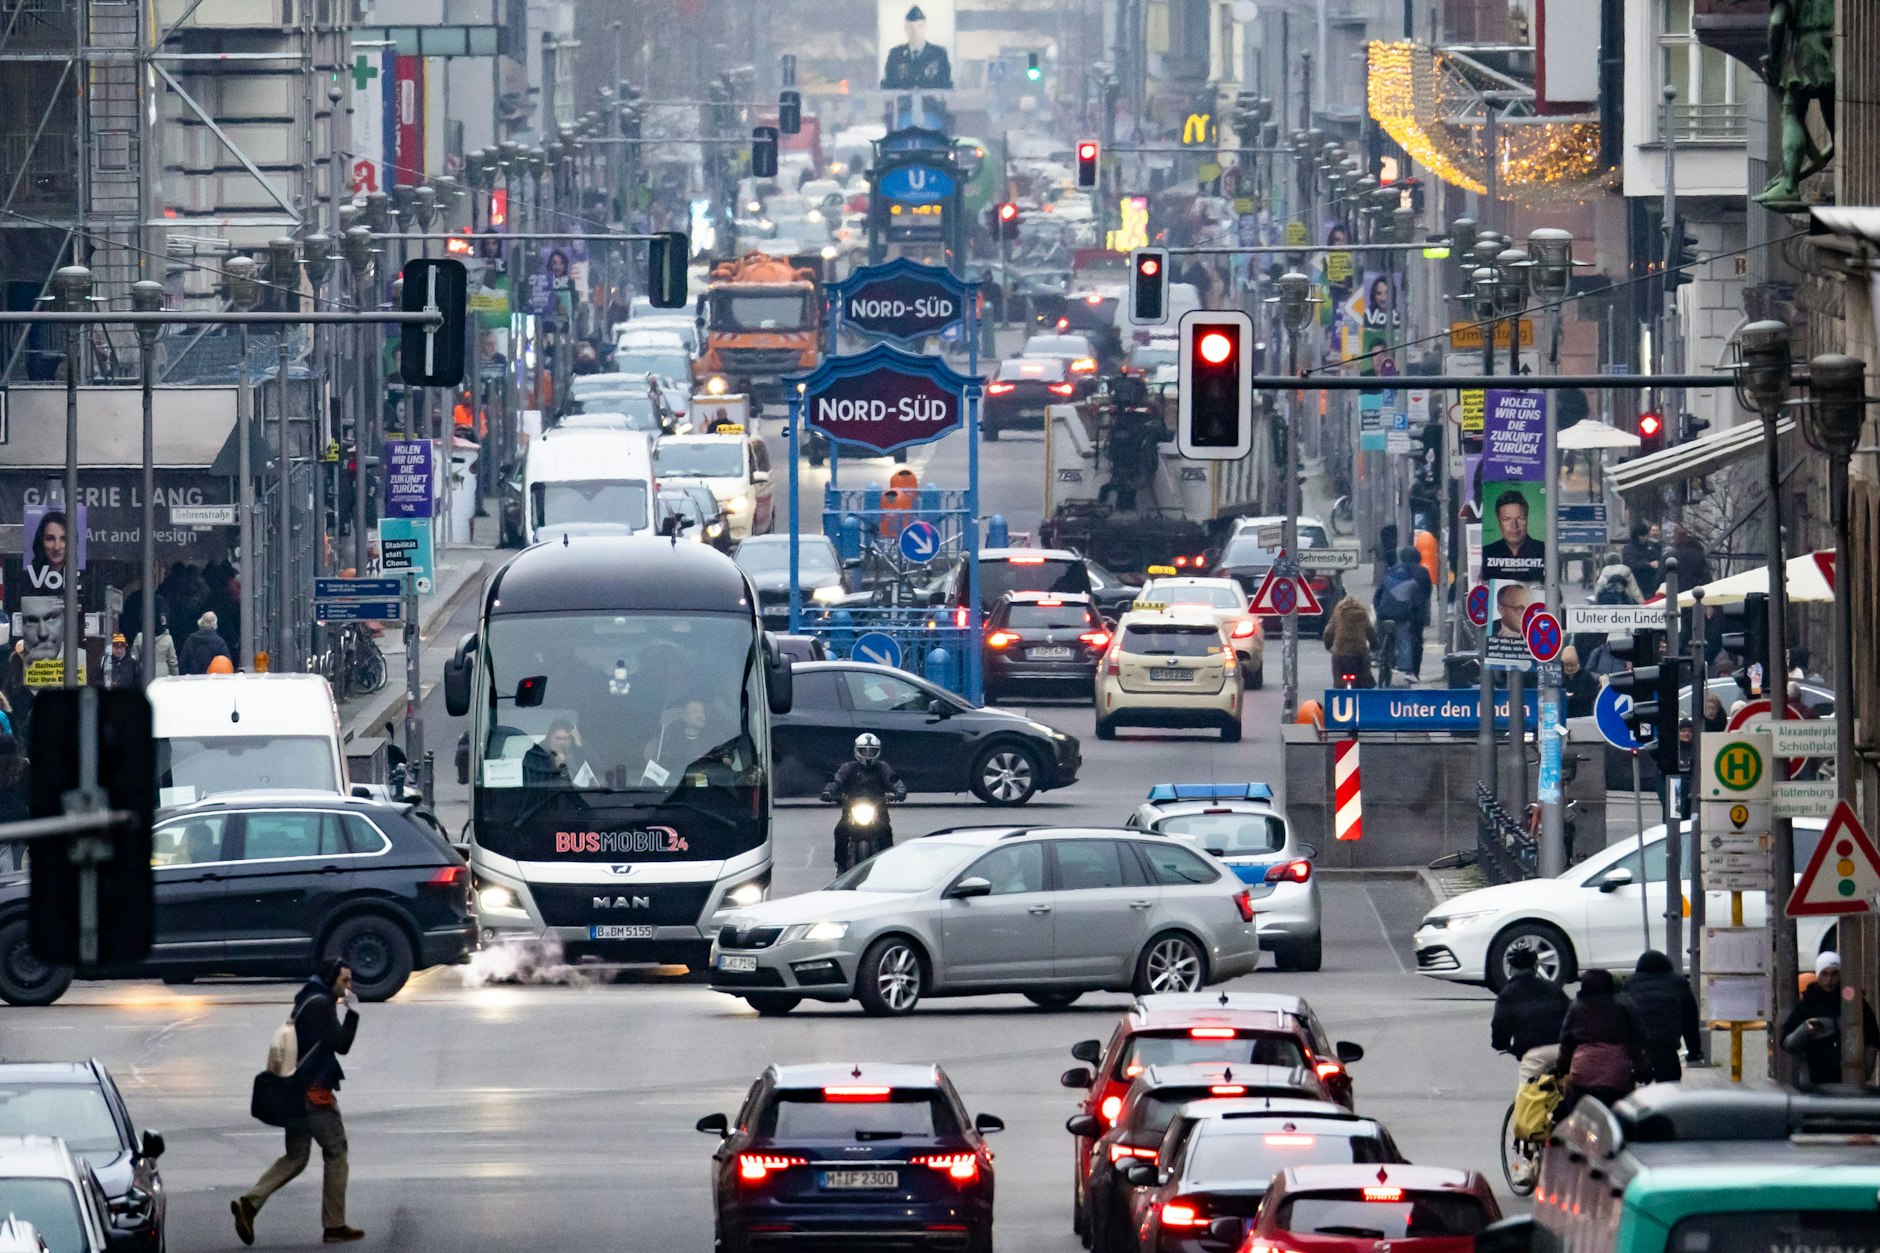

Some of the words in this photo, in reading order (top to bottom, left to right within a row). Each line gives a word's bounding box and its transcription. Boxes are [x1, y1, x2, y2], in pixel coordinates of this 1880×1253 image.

[852, 296, 953, 318] NORD-SÜD
[1366, 309, 1400, 325] Vot
[819, 395, 946, 421] NORD-SÜD
[1500, 397, 1537, 408] HOLEN
[1494, 408, 1516, 419] WIR
[1517, 409, 1541, 420] UNS
[1507, 420, 1527, 431] DIE
[1490, 430, 1543, 443] ZUKUNFT
[394, 445, 421, 454] HOLEN
[1492, 440, 1539, 454] ZURÜCK
[391, 455, 406, 464] WIR
[406, 455, 425, 465] UNS
[400, 465, 414, 474] DIE
[390, 475, 428, 484] ZUKUNFT
[392, 482, 425, 493] ZURÜCK
[175, 509, 231, 521] Behrenstraße
[86, 527, 107, 542] Art
[112, 527, 140, 542] and
[152, 528, 198, 546] esign
[384, 541, 417, 549] Stabilität
[385, 550, 402, 558] statt
[1298, 553, 1354, 565] Behrenstraße
[1487, 557, 1545, 568] ZUVERSICHT.
[1576, 611, 1608, 624] Unter
[1610, 611, 1631, 624] den
[1332, 695, 1353, 723] U
[1390, 701, 1435, 718] Unter
[1440, 701, 1471, 718] den
[1778, 726, 1837, 737] Alexanderpla
[1778, 741, 1837, 752] Schloßplat
[1727, 753, 1749, 780] H
[1815, 802, 1827, 812] Tor
[593, 896, 650, 908] MAN
[597, 926, 604, 937] B
[626, 926, 652, 937] 5155
[826, 1172, 835, 1185] M
[845, 1172, 858, 1185] IF
[862, 1172, 894, 1185] 2300
